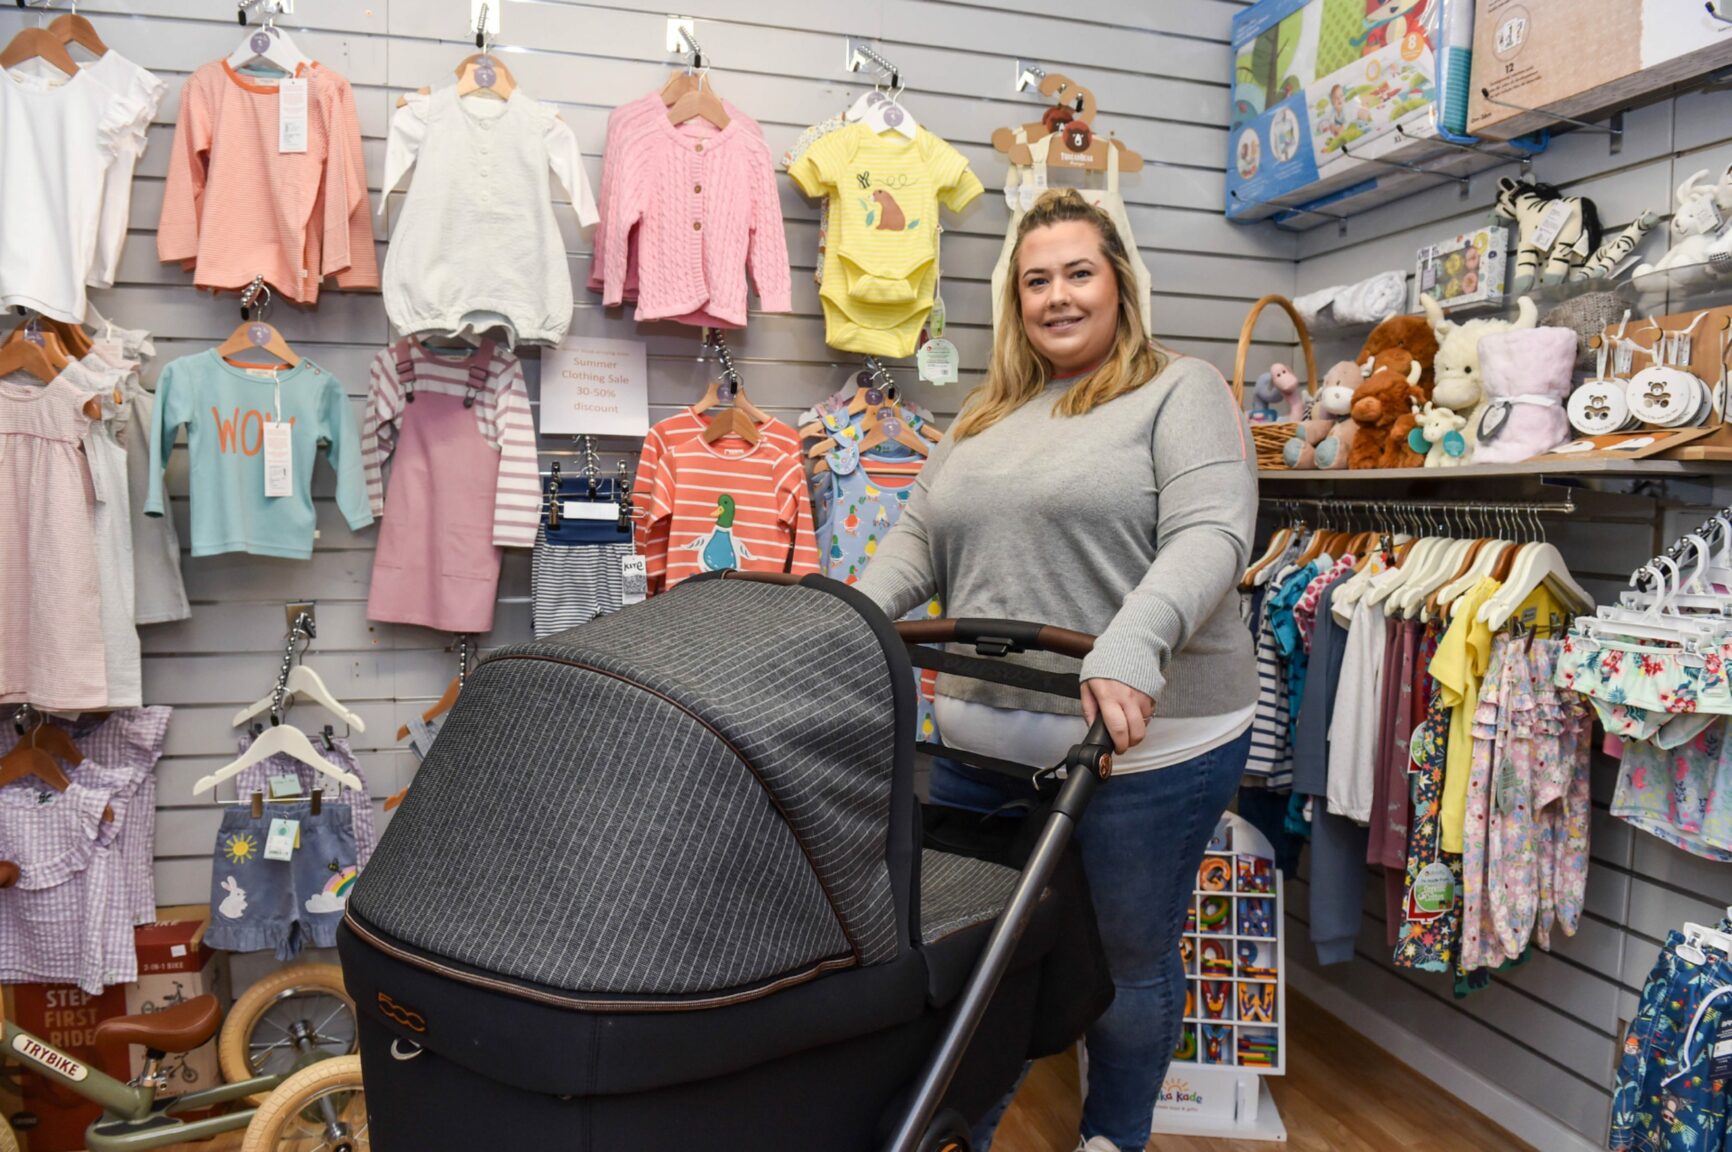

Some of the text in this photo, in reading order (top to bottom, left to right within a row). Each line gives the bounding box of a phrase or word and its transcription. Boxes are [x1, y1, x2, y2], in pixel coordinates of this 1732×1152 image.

[573, 357, 617, 369] Summer
[561, 369, 630, 385] Clothing Sale
[576, 386, 616, 398] 30-50%
[574, 402, 619, 413] discount
[211, 405, 296, 457] WO
[44, 1008, 97, 1028] FIRST
[49, 1029, 96, 1047] RIDE
[22, 1039, 80, 1077] TRYBIKE
[1176, 1091, 1203, 1104] kade
